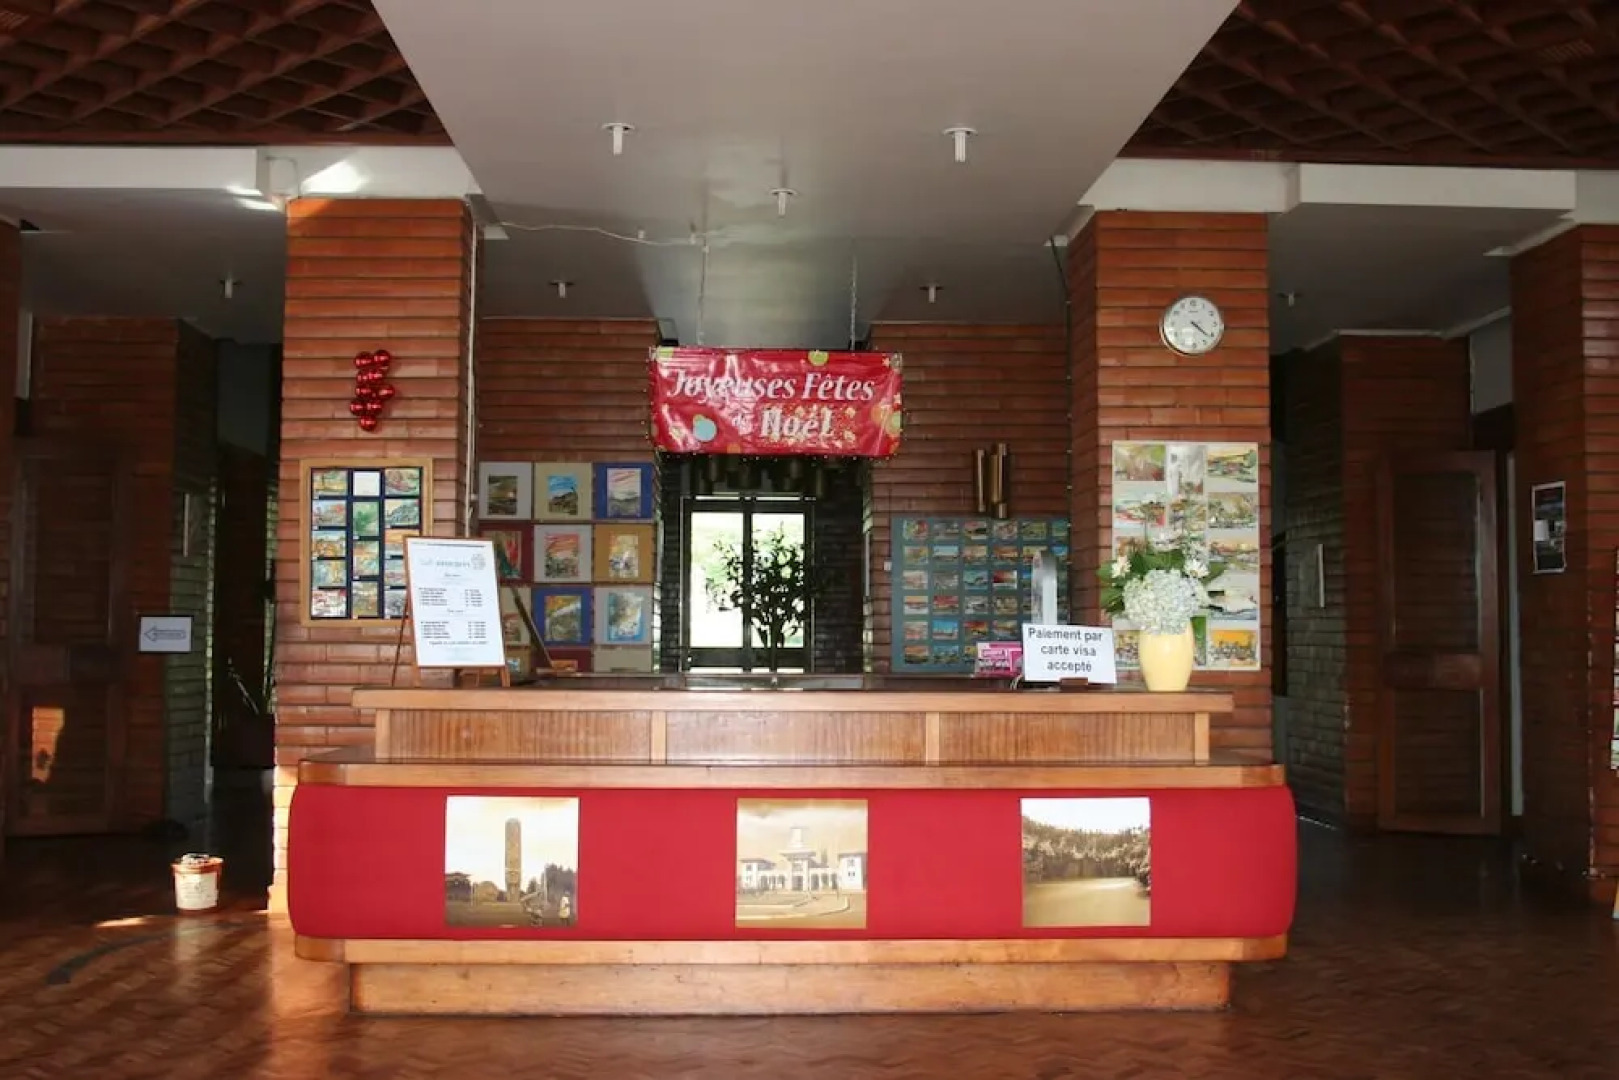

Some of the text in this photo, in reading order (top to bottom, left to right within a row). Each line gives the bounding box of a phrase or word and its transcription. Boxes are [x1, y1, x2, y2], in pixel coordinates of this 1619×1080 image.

[667, 369, 875, 403] Joyeuses Fêtes
[761, 404, 836, 439] Noël
[1027, 627, 1103, 643] Paiement par
[1040, 644, 1097, 657] carte visa
[1047, 660, 1092, 673] accepté
